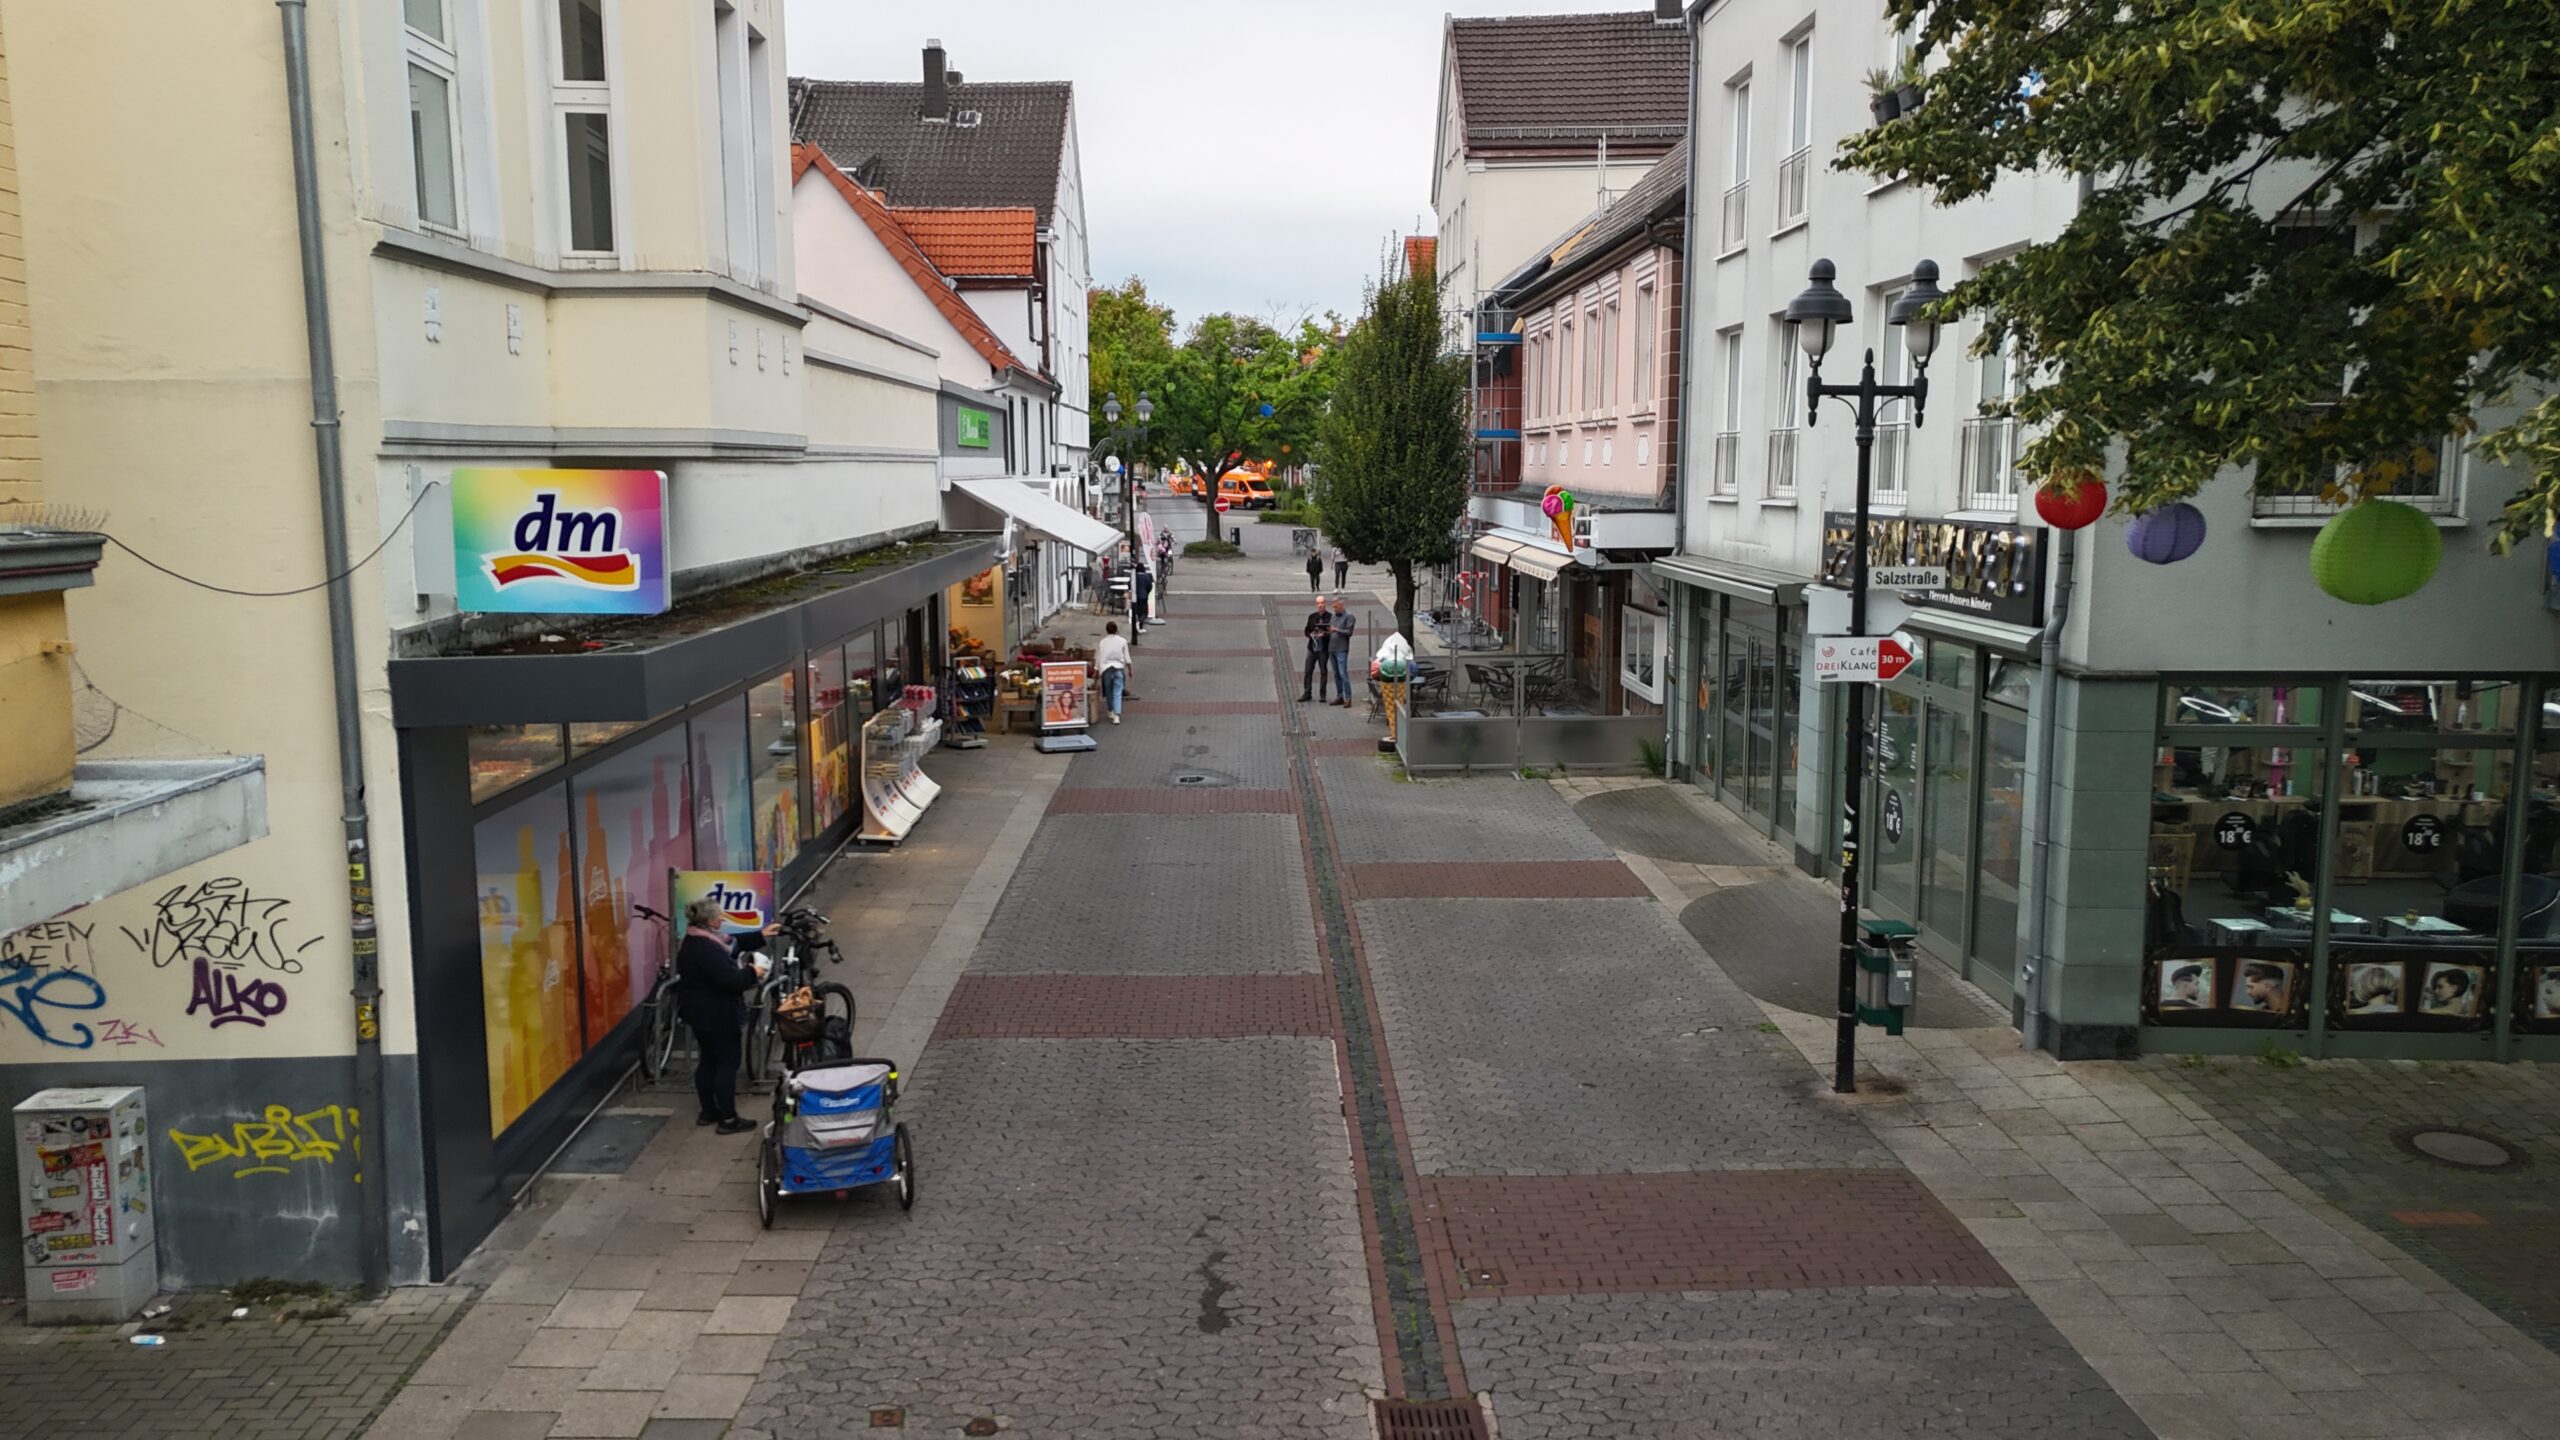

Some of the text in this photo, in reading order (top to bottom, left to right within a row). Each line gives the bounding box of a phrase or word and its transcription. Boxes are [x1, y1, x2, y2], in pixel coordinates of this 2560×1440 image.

[514, 493, 617, 552] dm
[1875, 571, 1938, 586] Salzstraße
[1850, 646, 1876, 656] Café
[1881, 655, 1905, 664] 30 m
[185, 956, 287, 1018] ALKO
